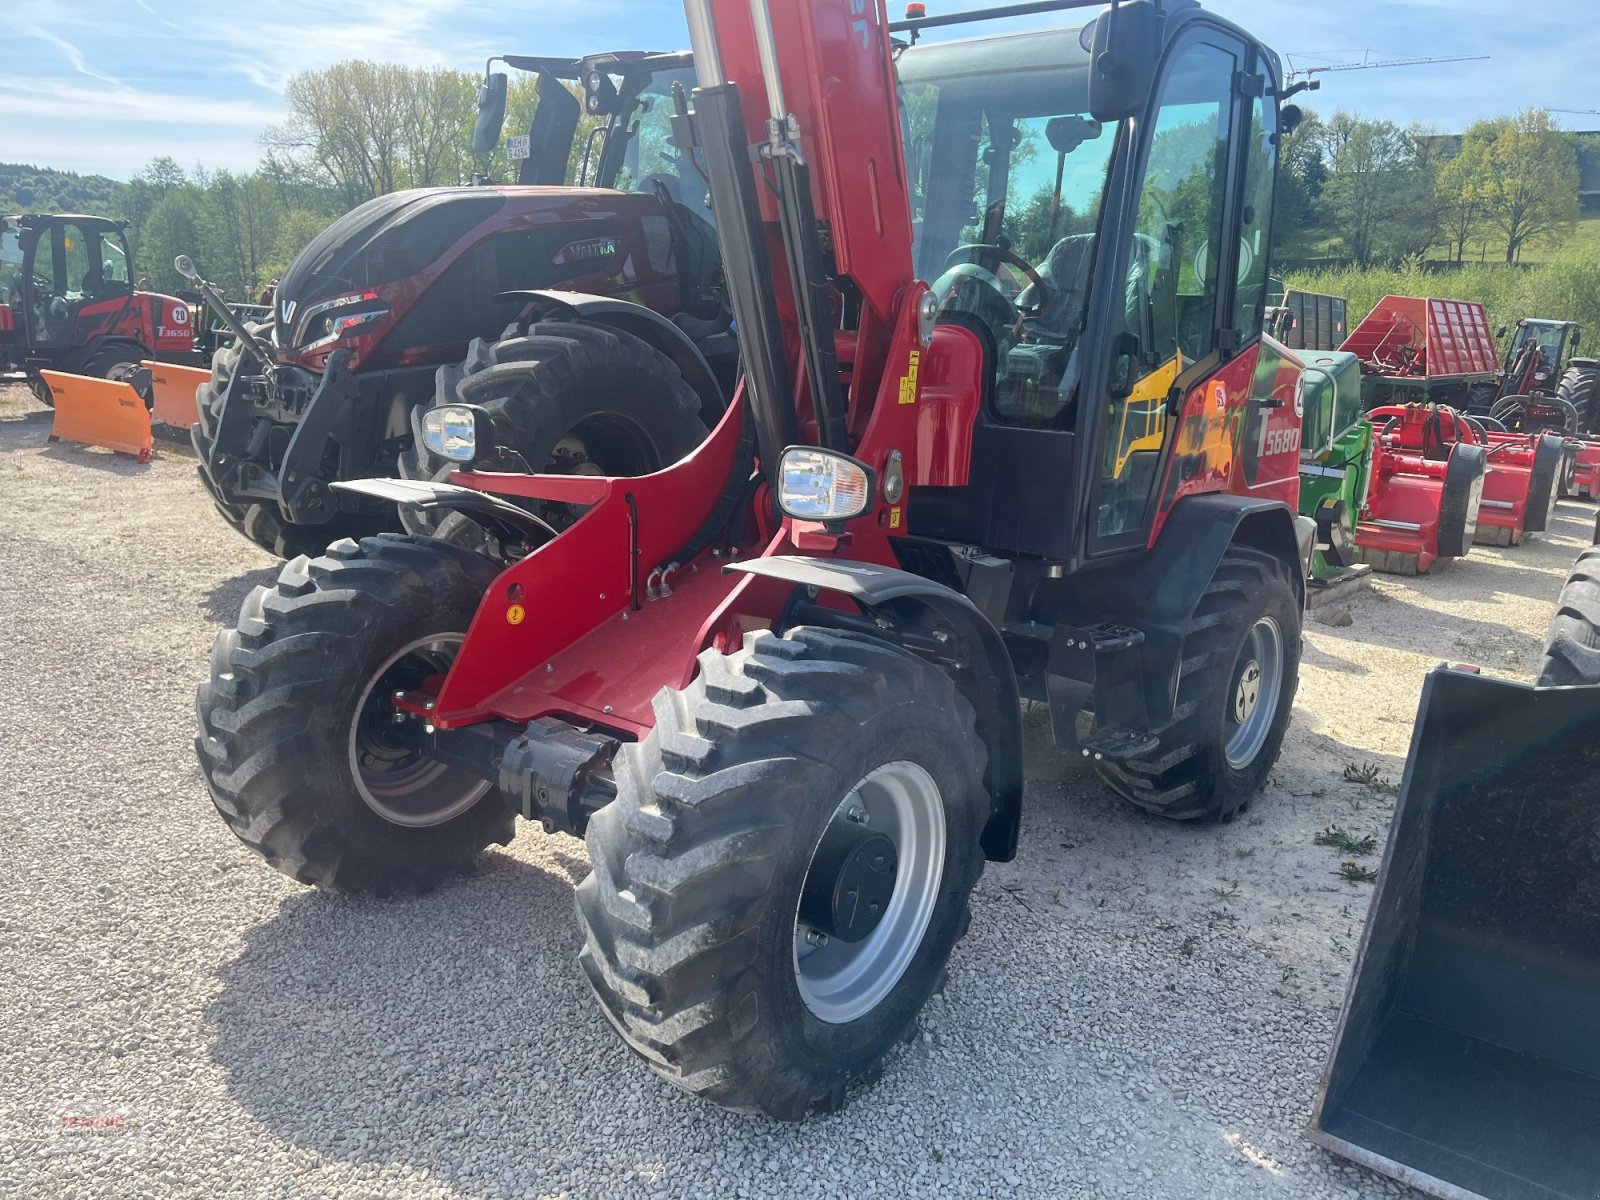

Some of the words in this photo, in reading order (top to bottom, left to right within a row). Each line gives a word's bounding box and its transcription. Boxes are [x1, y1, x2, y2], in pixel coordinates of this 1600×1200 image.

[175, 310, 185, 321] 20
[157, 326, 190, 337] T3650
[1256, 407, 1300, 457] T5680
